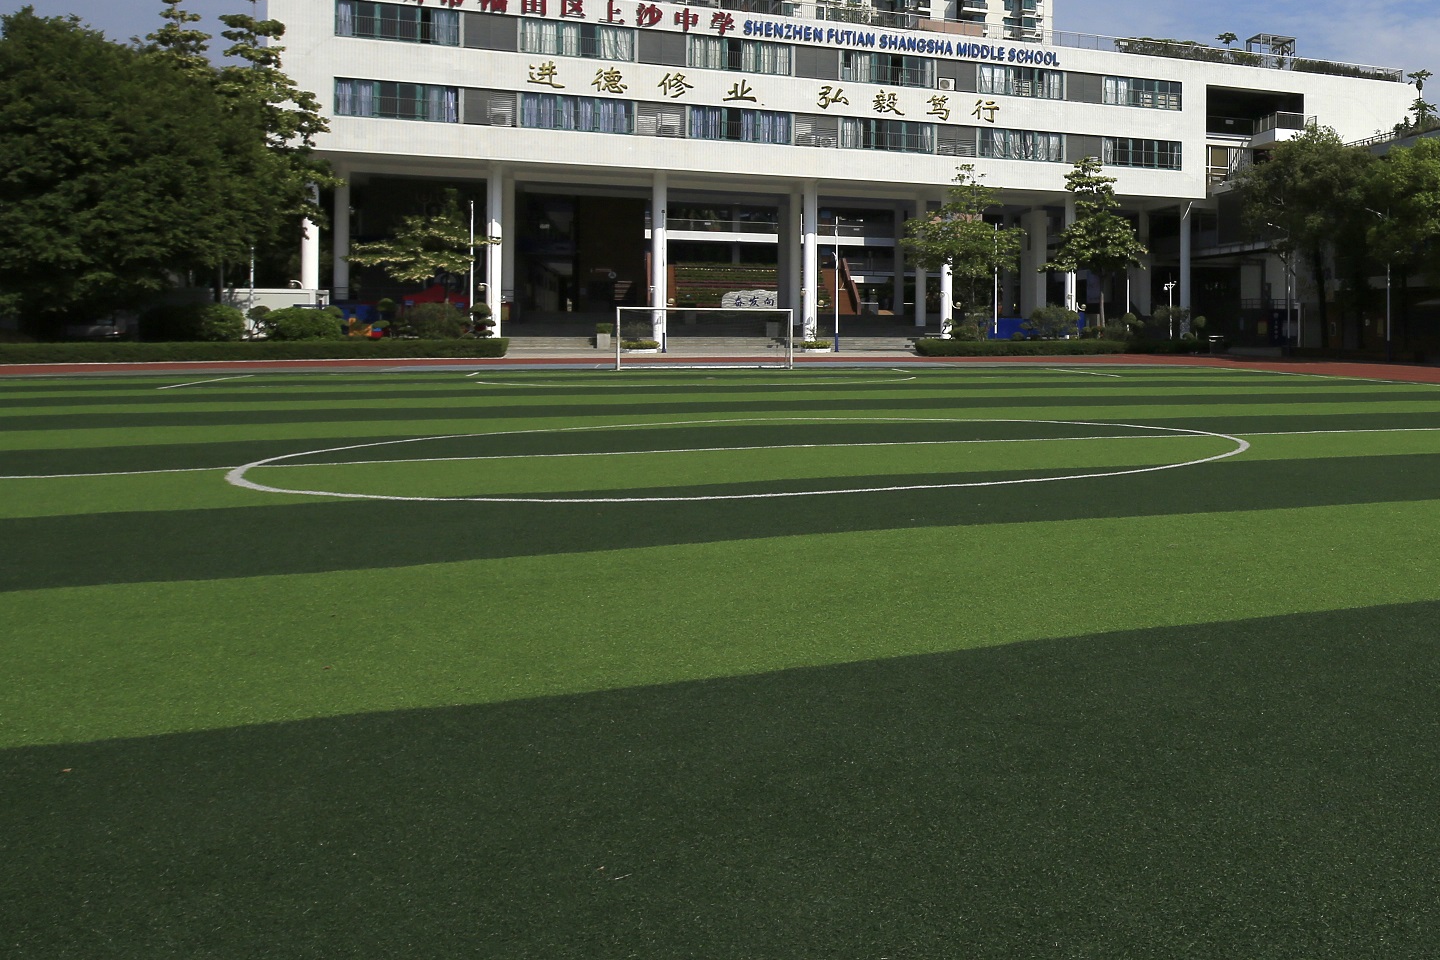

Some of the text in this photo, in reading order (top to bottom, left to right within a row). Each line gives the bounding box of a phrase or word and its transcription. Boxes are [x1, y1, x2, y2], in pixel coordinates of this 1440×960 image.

[743, 19, 1060, 67] SHENZHEN FUTIAN SHANGSHA MIDDLE SCHOOL
[526, 60, 1000, 124] 进德修业 弘毅笃行
